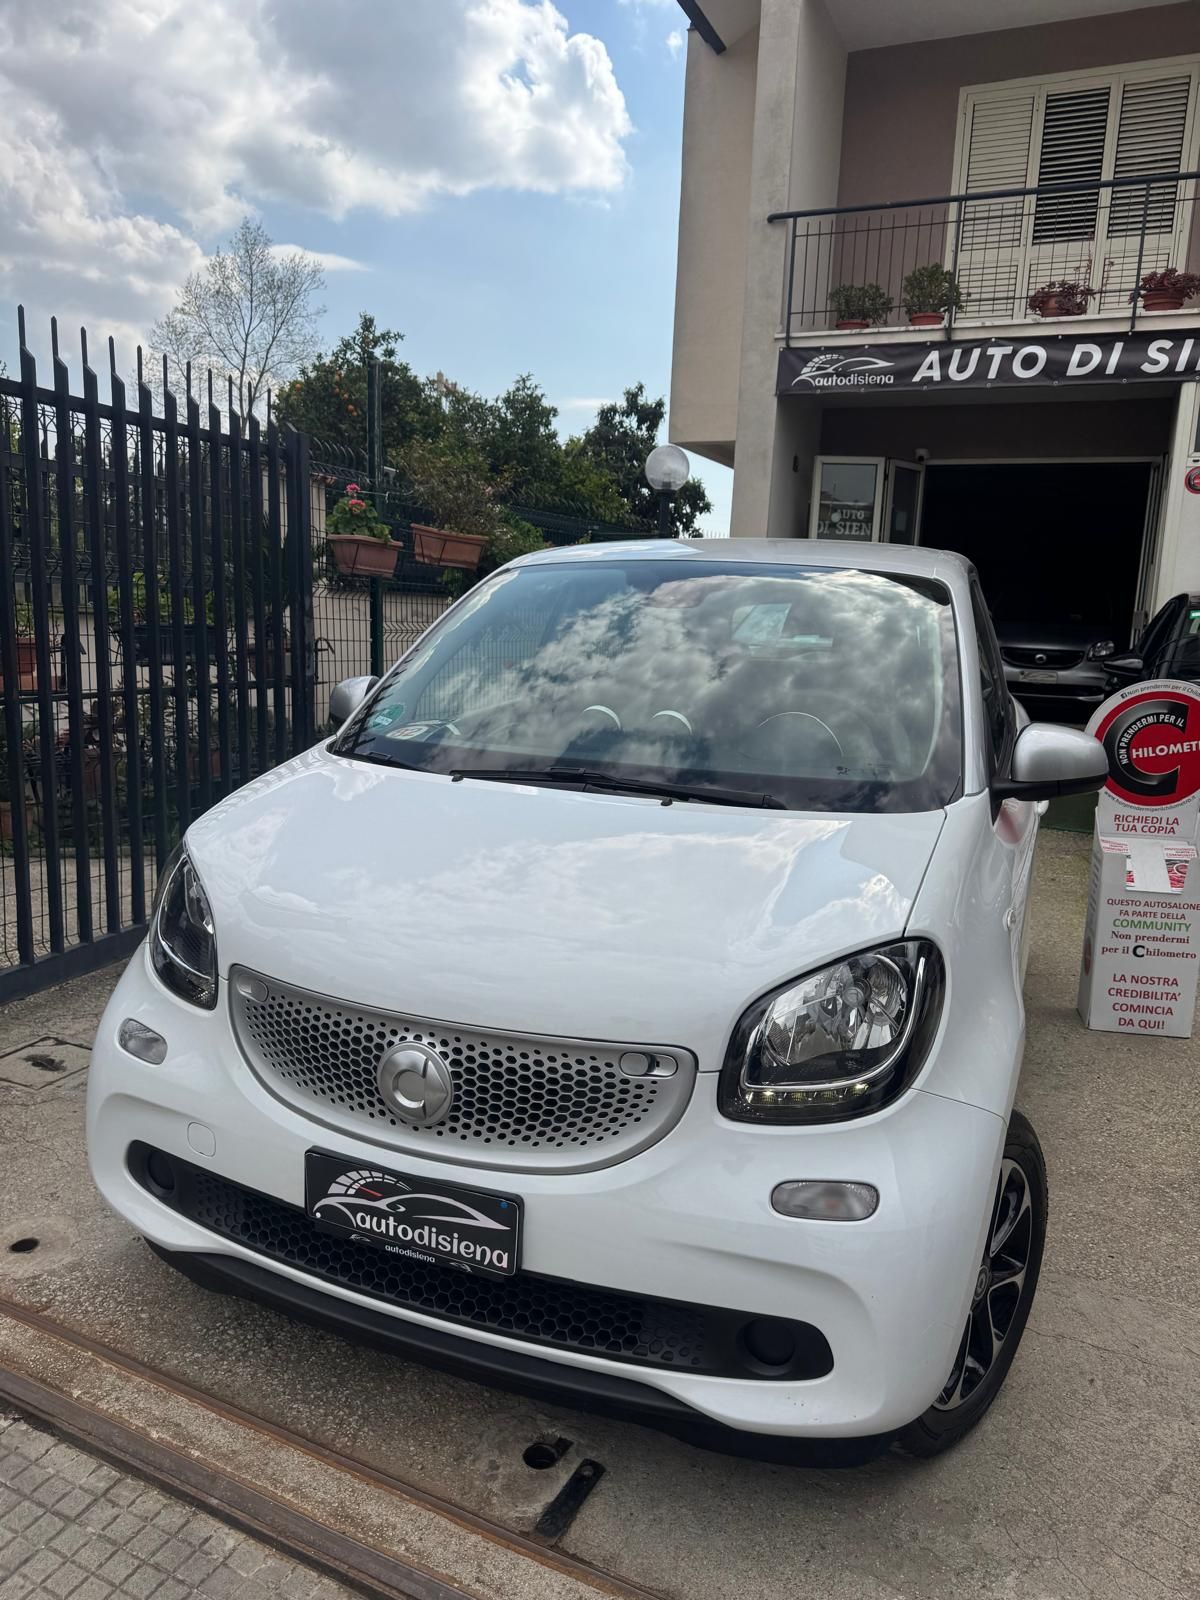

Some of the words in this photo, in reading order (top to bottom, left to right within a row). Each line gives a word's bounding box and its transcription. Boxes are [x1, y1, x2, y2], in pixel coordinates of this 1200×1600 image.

[912, 345, 1047, 383] AUTO
[1066, 342, 1124, 376] DI
[1140, 338, 1200, 373] SI
[814, 372, 894, 387] autodisiena
[1160, 714, 1176, 723] PER
[1176, 717, 1185, 727] IL
[1120, 715, 1157, 747] PRENDERMI
[1119, 749, 1129, 765] NON
[1113, 814, 1163, 826] RICHIEDI
[1166, 816, 1180, 826] LA
[1115, 823, 1137, 833] TUA
[1140, 825, 1176, 835] COPIA
[1107, 898, 1142, 907] QUESTO
[1143, 900, 1200, 911] AUTOSALONE
[1131, 910, 1158, 919] PARTE
[1160, 912, 1186, 921] DELLA
[1112, 918, 1192, 932] COMMUNITY
[1111, 930, 1132, 940] Non
[1135, 934, 1190, 944] prendermi
[1101, 946, 1120, 955] per
[1122, 946, 1130, 954] il
[1132, 944, 1197, 960] Chilometro
[1112, 973, 1127, 984] LA
[1130, 975, 1179, 987] NOSTRA
[1112, 1002, 1174, 1016] COMINCIA
[1118, 1017, 1135, 1027] DA
[1138, 1019, 1165, 1030] QUI!
[356, 1211, 509, 1269] autodisiena
[384, 1243, 436, 1264] autodisiena
